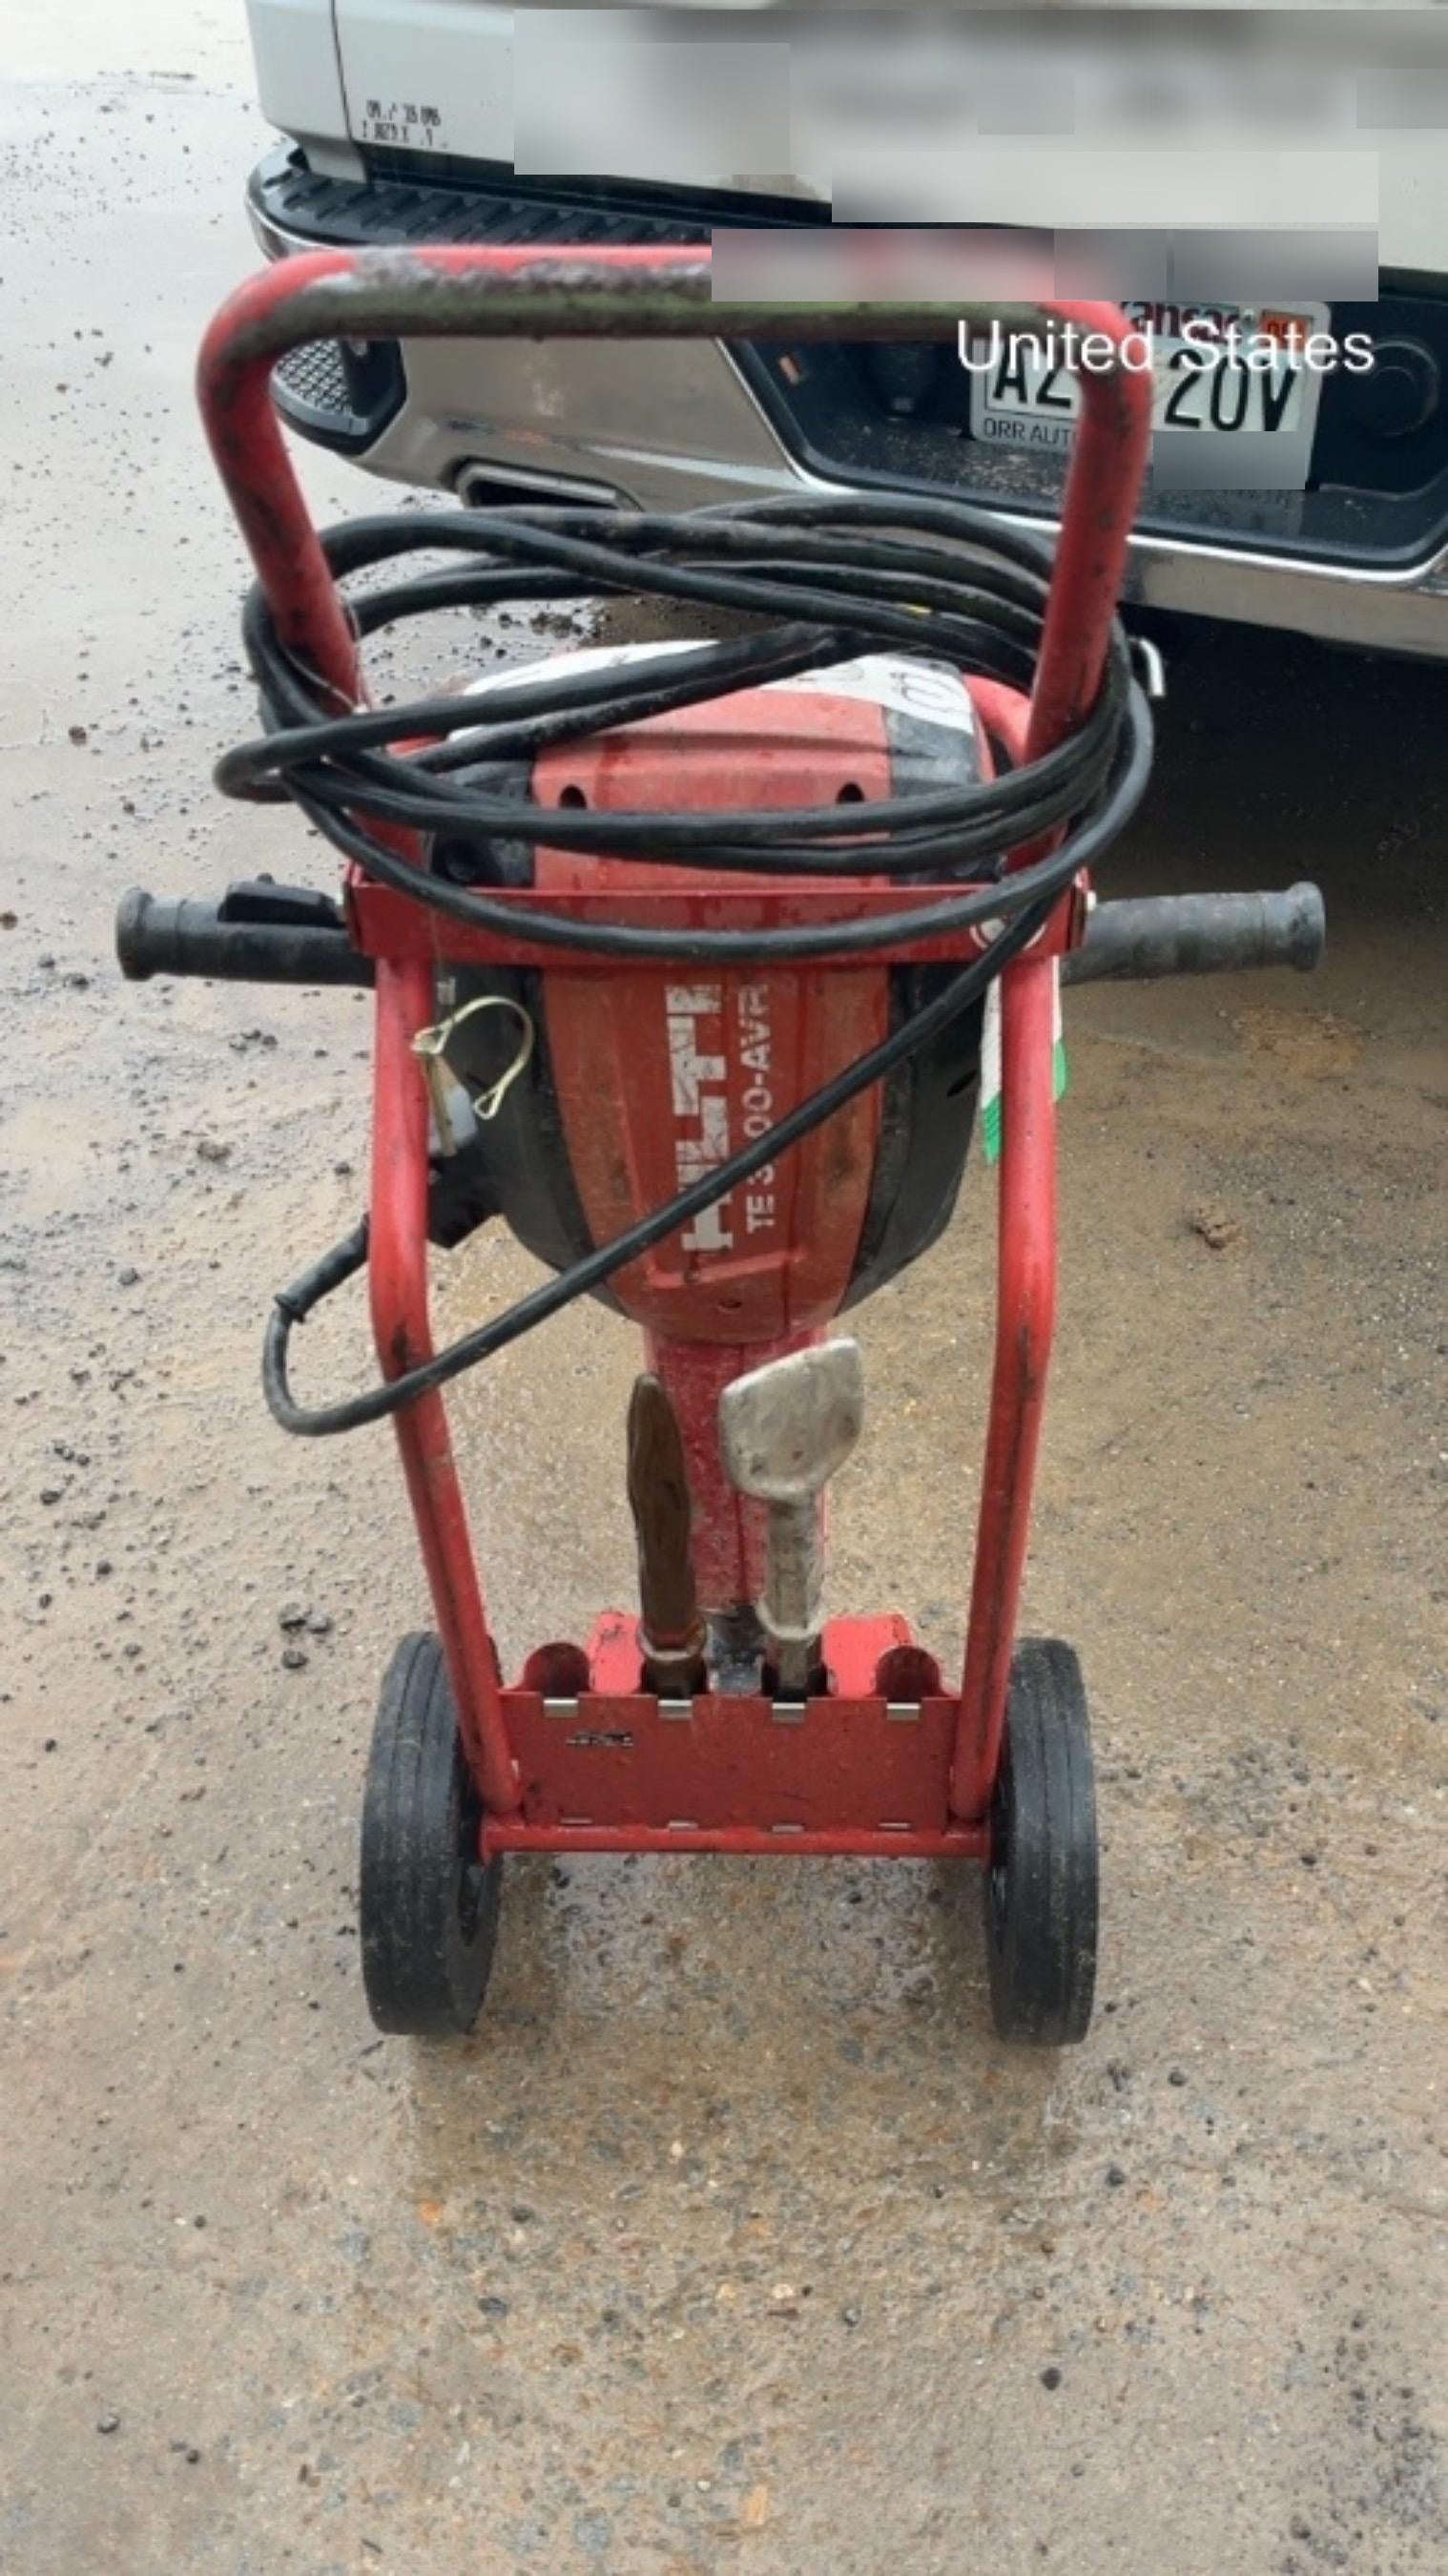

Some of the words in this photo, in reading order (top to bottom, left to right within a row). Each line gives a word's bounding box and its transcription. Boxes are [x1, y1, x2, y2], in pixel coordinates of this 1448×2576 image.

[1165, 347, 1296, 431] 20V
[1030, 423, 1077, 447] AUT
[666, 984, 734, 1252] HILTI
[738, 984, 775, 1186] 300-AVR
[746, 1195, 776, 1234] TE
